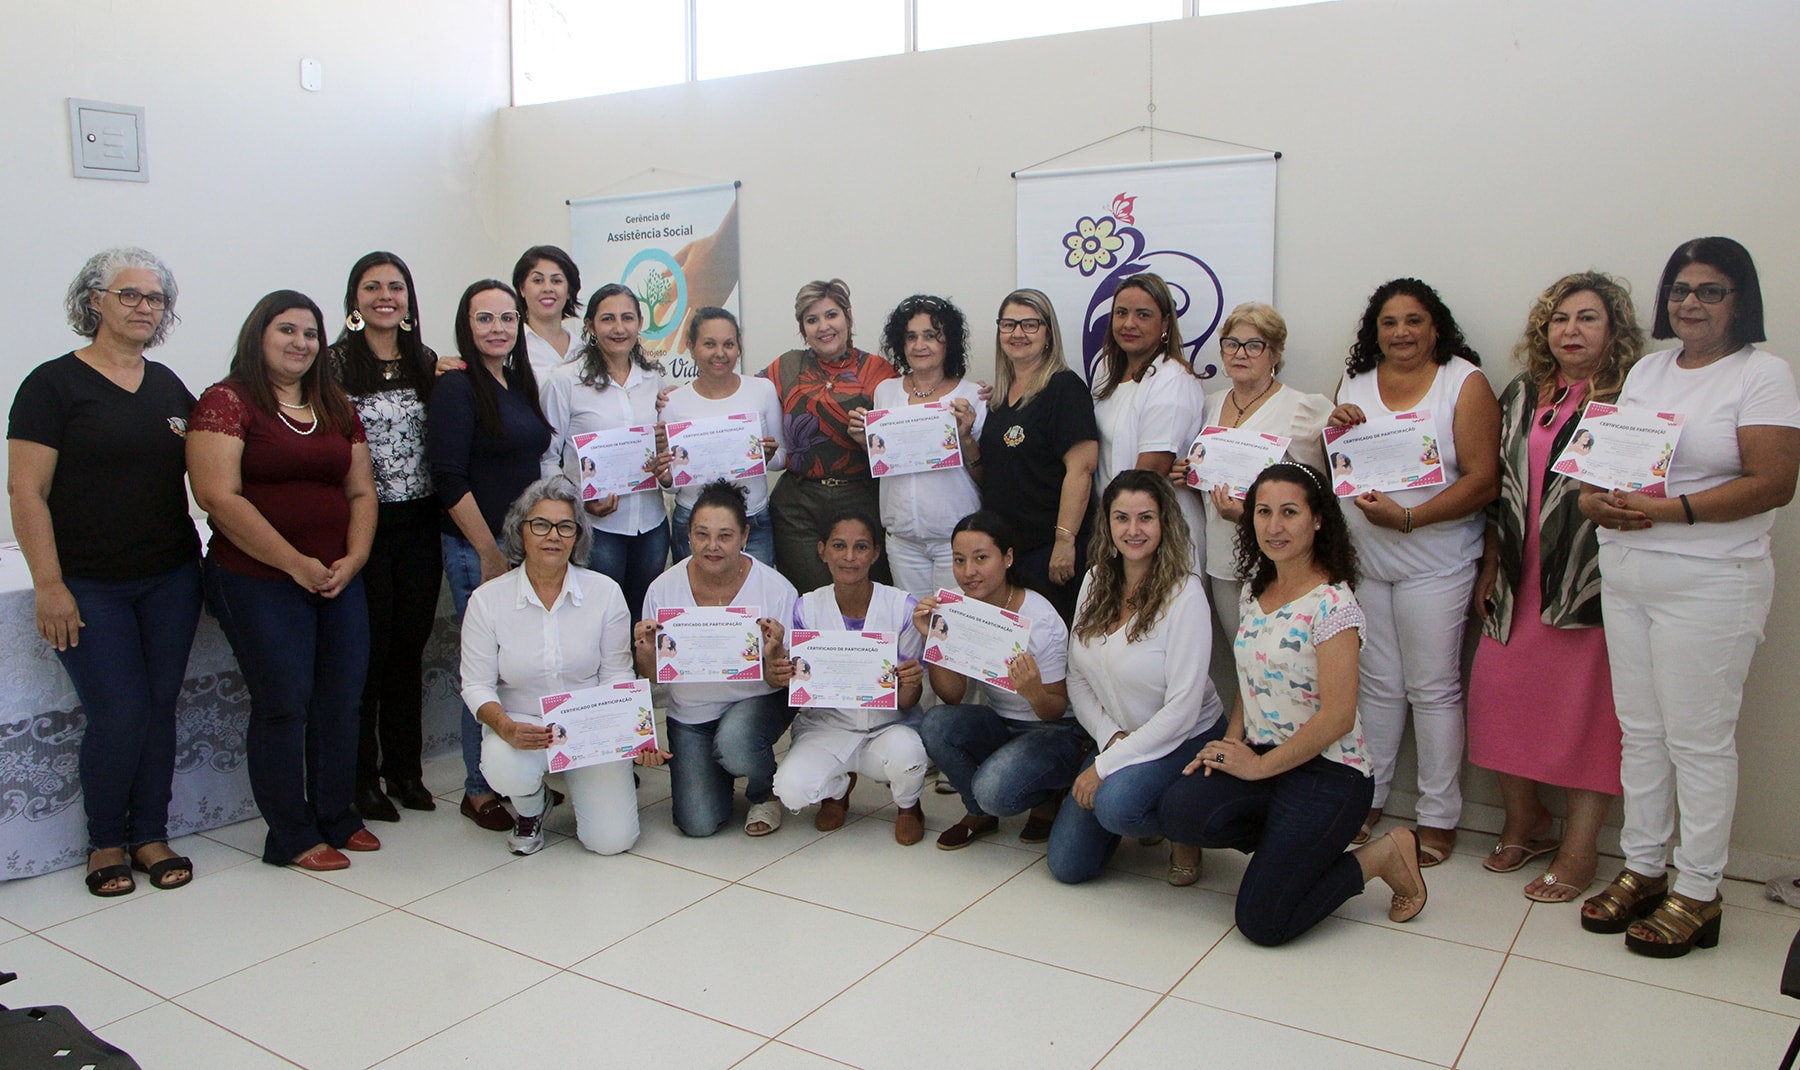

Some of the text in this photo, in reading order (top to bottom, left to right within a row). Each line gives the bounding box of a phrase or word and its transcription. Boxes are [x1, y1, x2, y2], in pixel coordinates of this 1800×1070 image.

[625, 212, 671, 224] Gerência de
[607, 225, 693, 243] Assistência Social
[560, 704, 590, 714] CERTIFICADO
